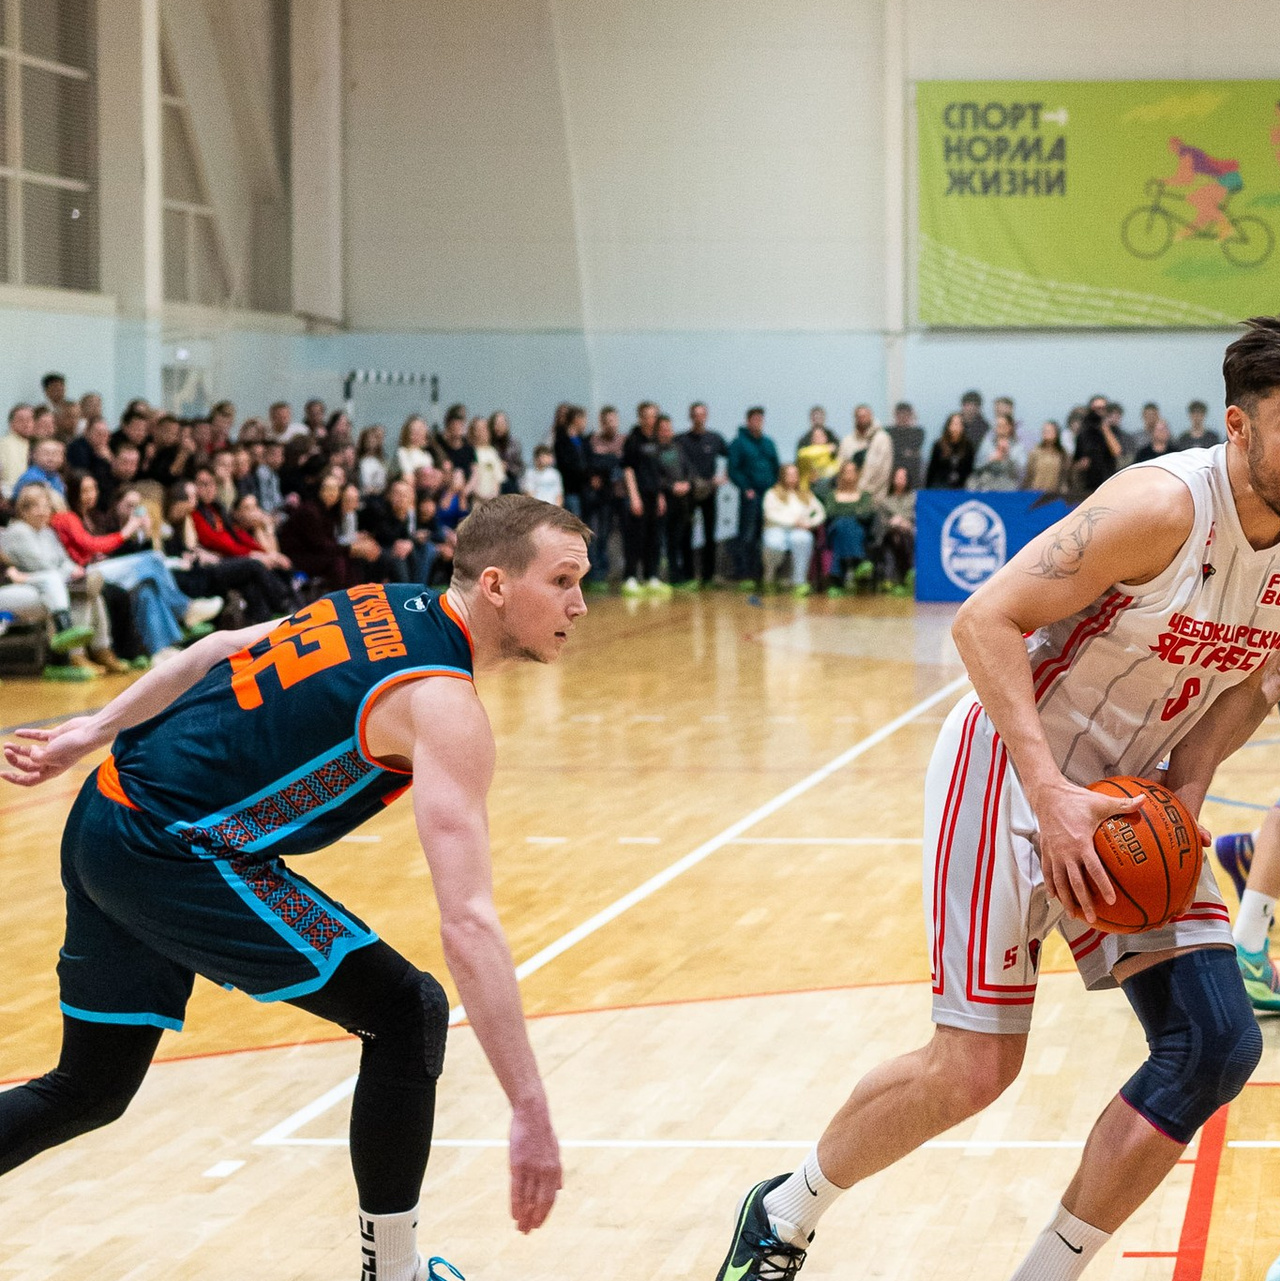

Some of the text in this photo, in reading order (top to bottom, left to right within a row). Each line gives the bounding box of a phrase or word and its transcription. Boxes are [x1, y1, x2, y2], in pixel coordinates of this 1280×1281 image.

[944, 102, 1042, 130] СПОРТ
[944, 135, 1066, 162] НОРМА
[945, 169, 1066, 195] ЖИЗНИ
